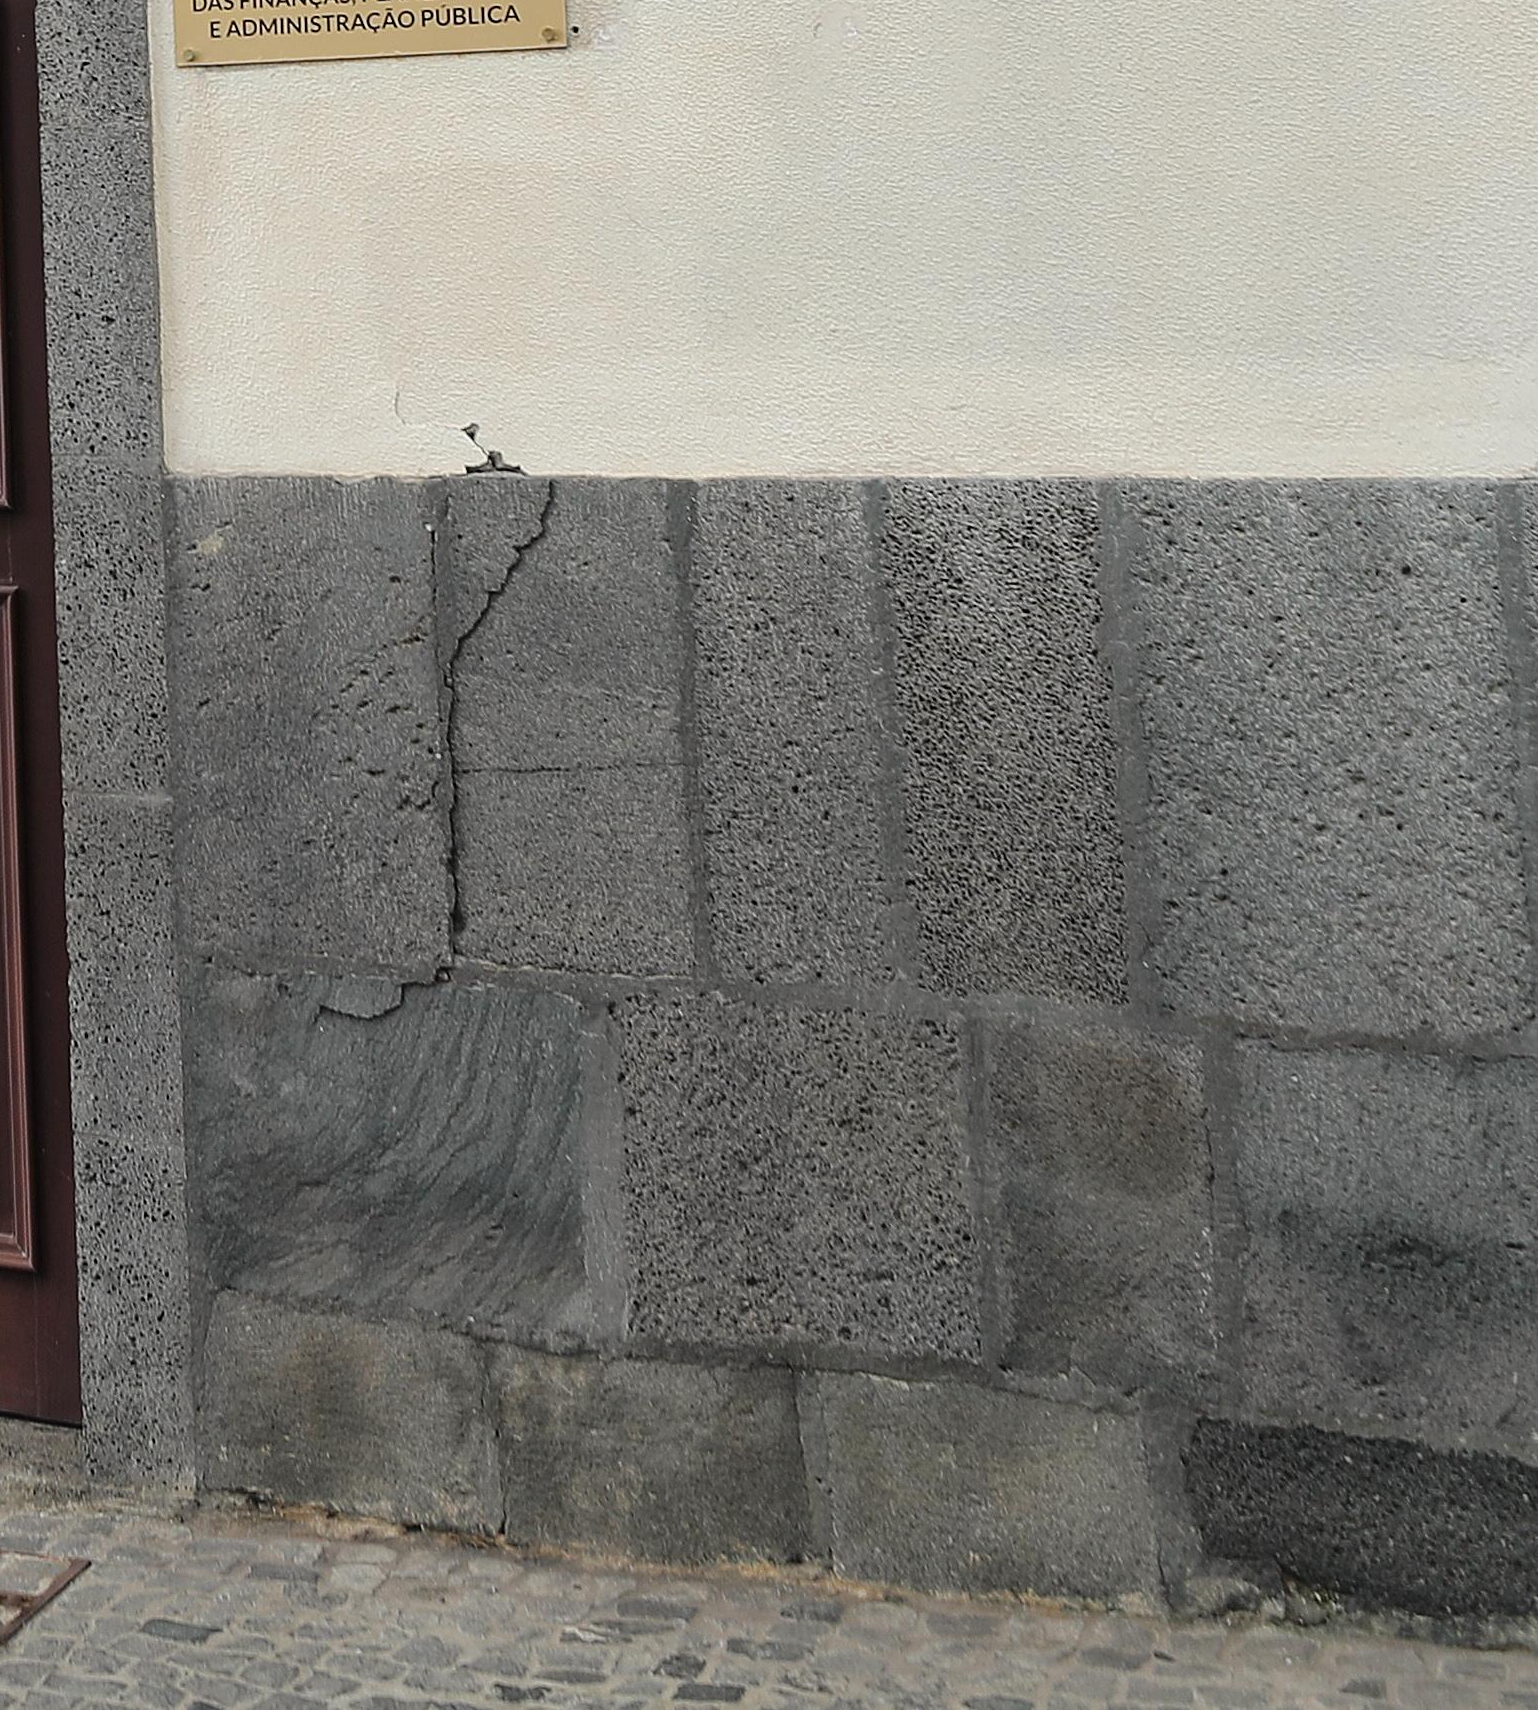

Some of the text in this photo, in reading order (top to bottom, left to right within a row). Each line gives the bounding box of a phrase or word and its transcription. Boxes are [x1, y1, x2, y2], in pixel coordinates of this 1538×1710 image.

[210, 4, 520, 38] E ADMINISTRAÇÃO PÚBLICA
